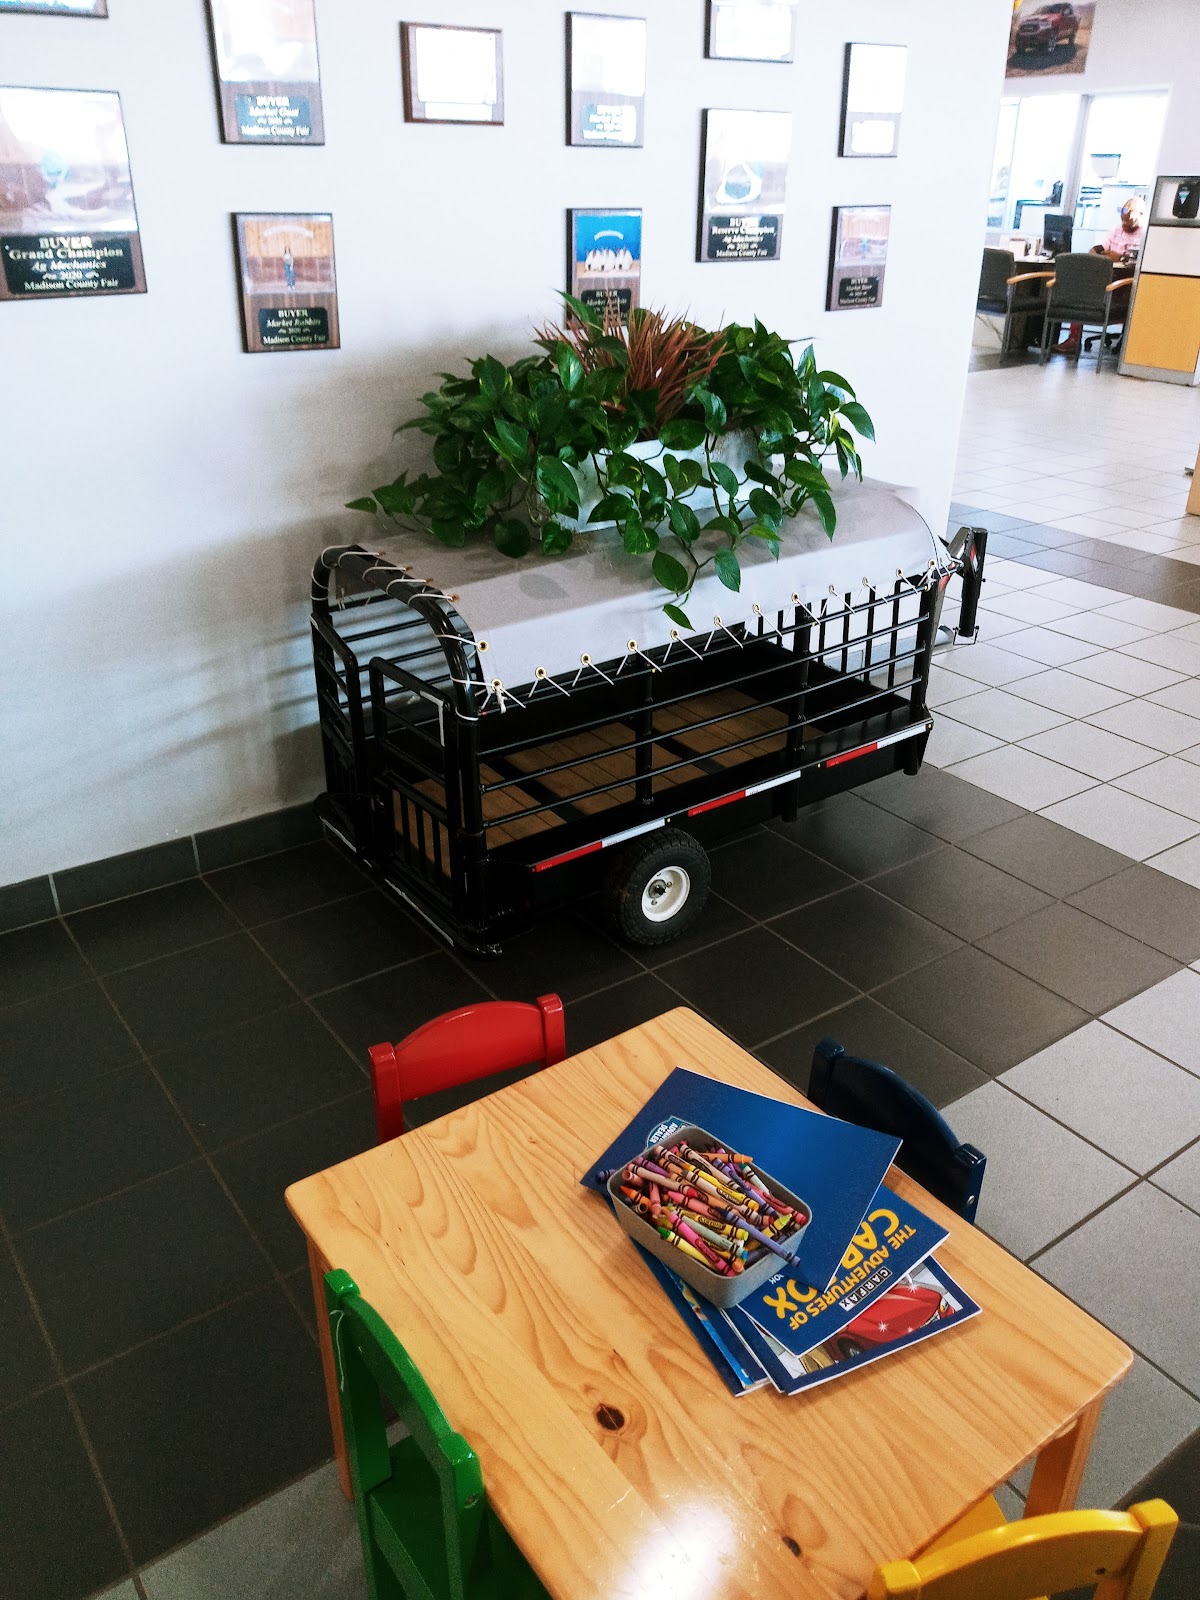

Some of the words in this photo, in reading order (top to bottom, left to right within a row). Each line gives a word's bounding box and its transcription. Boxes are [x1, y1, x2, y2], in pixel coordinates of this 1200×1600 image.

[241, 125, 271, 135] Madison
[270, 125, 296, 137] County
[296, 125, 310, 136] Fair
[711, 226, 740, 235] Reserve
[39, 235, 93, 249] BUYER
[9, 249, 54, 261] Grand
[56, 246, 124, 260] Champion
[716, 249, 738, 257] Madison
[738, 249, 757, 258] County
[757, 248, 768, 257] Fair
[32, 261, 47, 272] Ag
[50, 259, 107, 271] Mechanics
[24, 280, 64, 291] Madison
[65, 279, 99, 290] County
[100, 278, 119, 288] Fair
[278, 309, 309, 318] BUYER
[266, 319, 293, 329] Market
[263, 336, 290, 345] Madison
[290, 334, 313, 343] County
[314, 333, 326, 342] Fair
[649, 1123, 668, 1144] DEALER
[887, 1224, 917, 1250] THE
[806, 1245, 890, 1318] ADVENTURES
[840, 1267, 892, 1311] CARFAX
[763, 1276, 837, 1319] OX
[789, 1311, 809, 1331] OF
